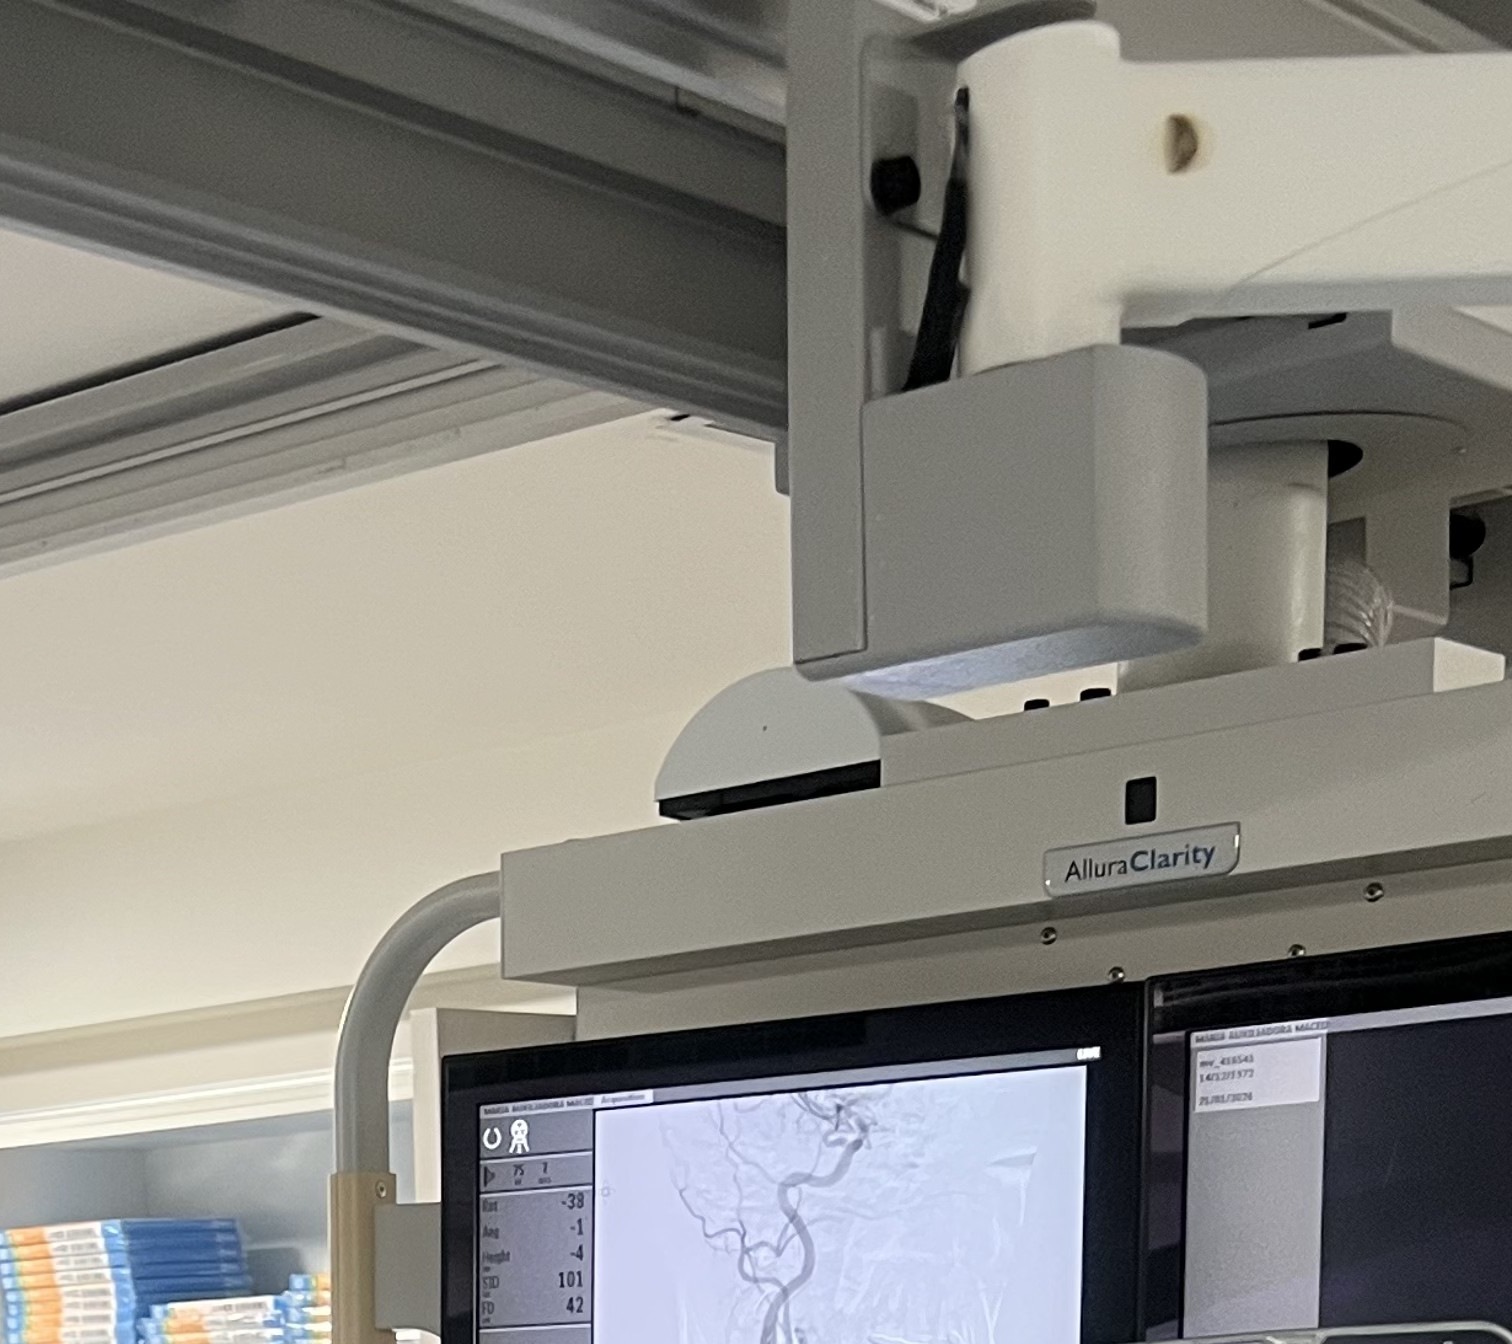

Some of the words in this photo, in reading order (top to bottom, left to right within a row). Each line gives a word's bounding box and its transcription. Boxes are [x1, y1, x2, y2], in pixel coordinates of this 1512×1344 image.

[1064, 844, 1216, 883] AlluraClarity
[570, 1217, 584, 1236] -1
[570, 1244, 584, 1262] -4
[558, 1270, 584, 1288] 101
[566, 1296, 584, 1314] 42
